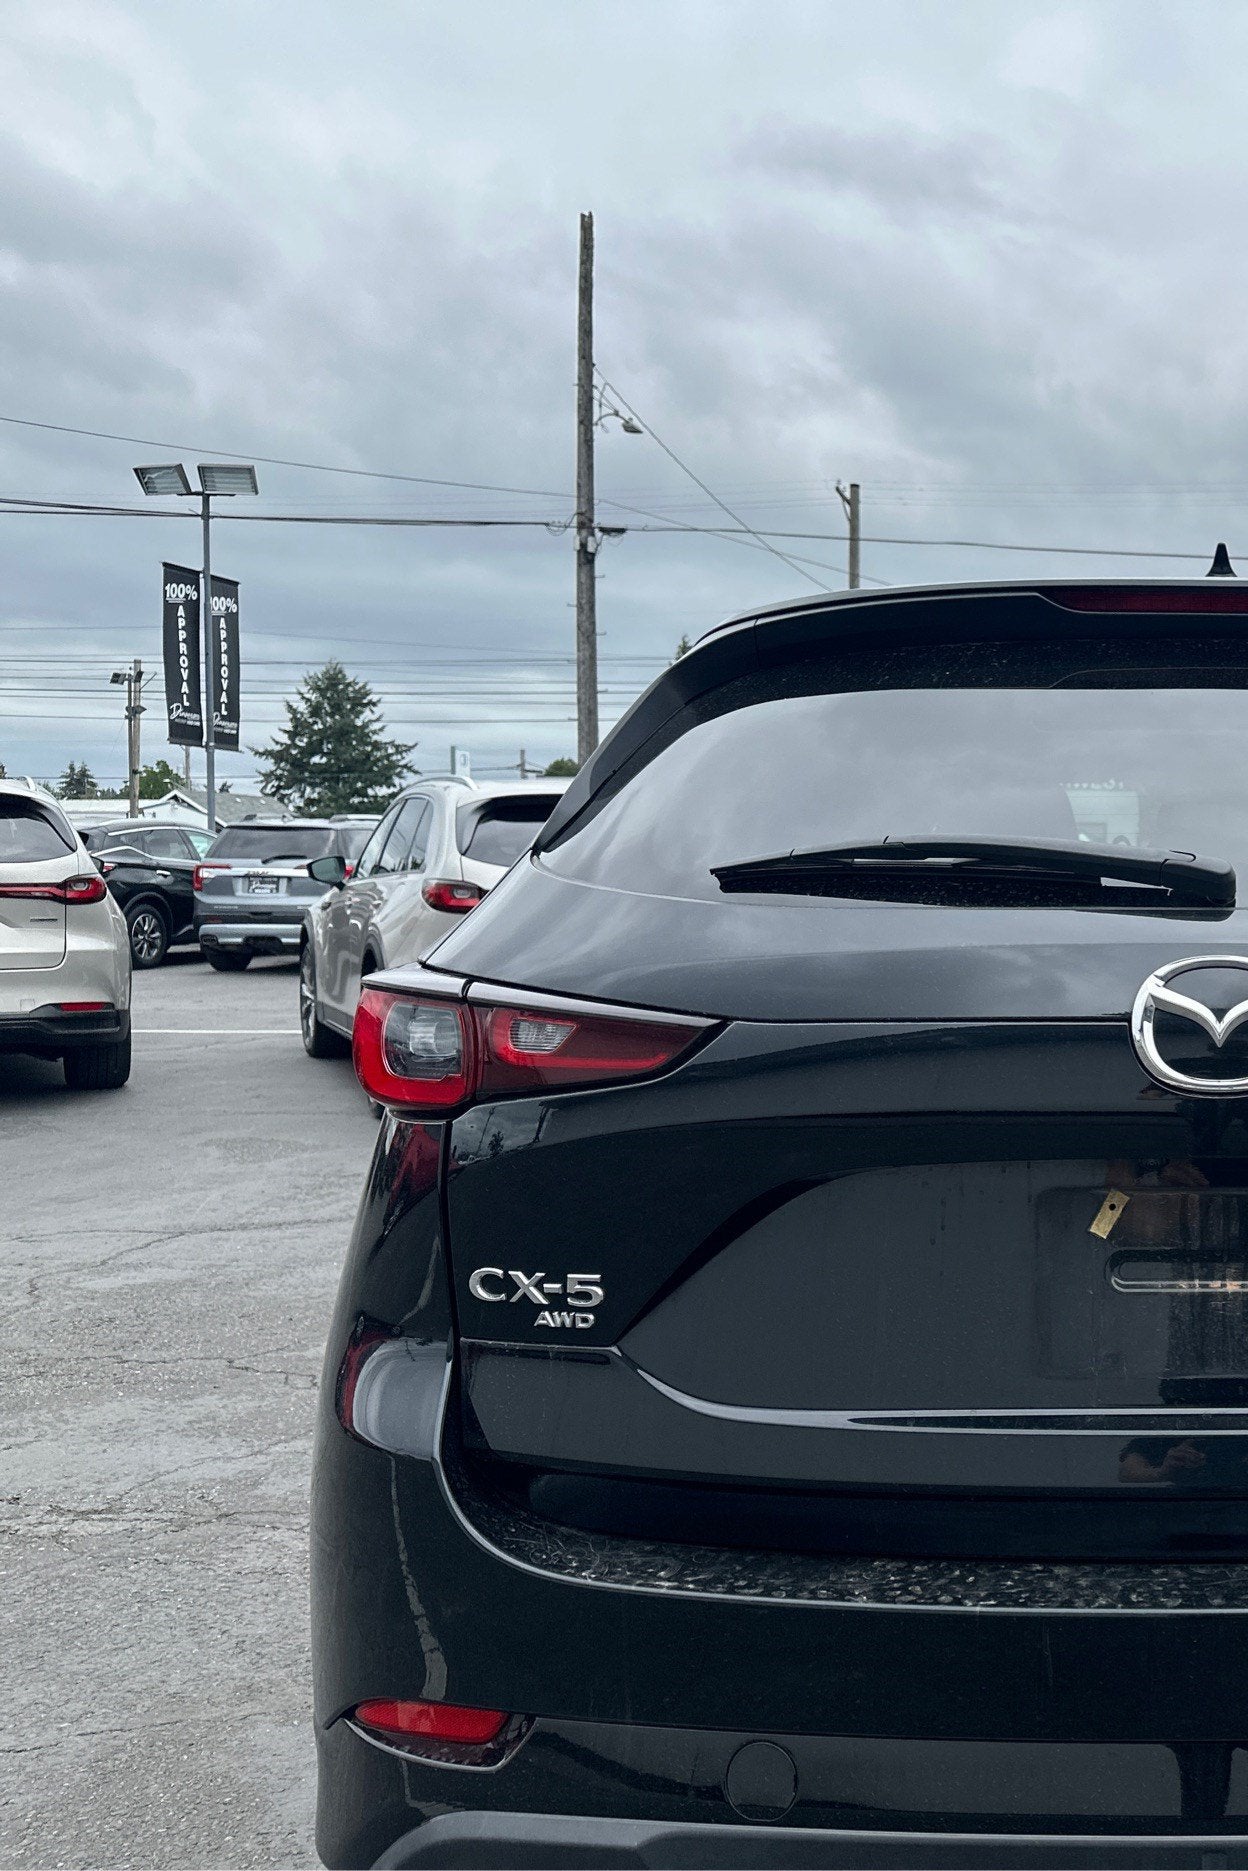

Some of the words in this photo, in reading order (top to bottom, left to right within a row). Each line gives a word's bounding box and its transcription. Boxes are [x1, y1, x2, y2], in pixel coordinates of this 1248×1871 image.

[165, 583, 198, 600] 100%
[177, 605, 190, 707] APPROVAL
[219, 617, 229, 716] APPROVAL
[468, 1267, 604, 1308] CX-5
[533, 1310, 595, 1329] AWD
